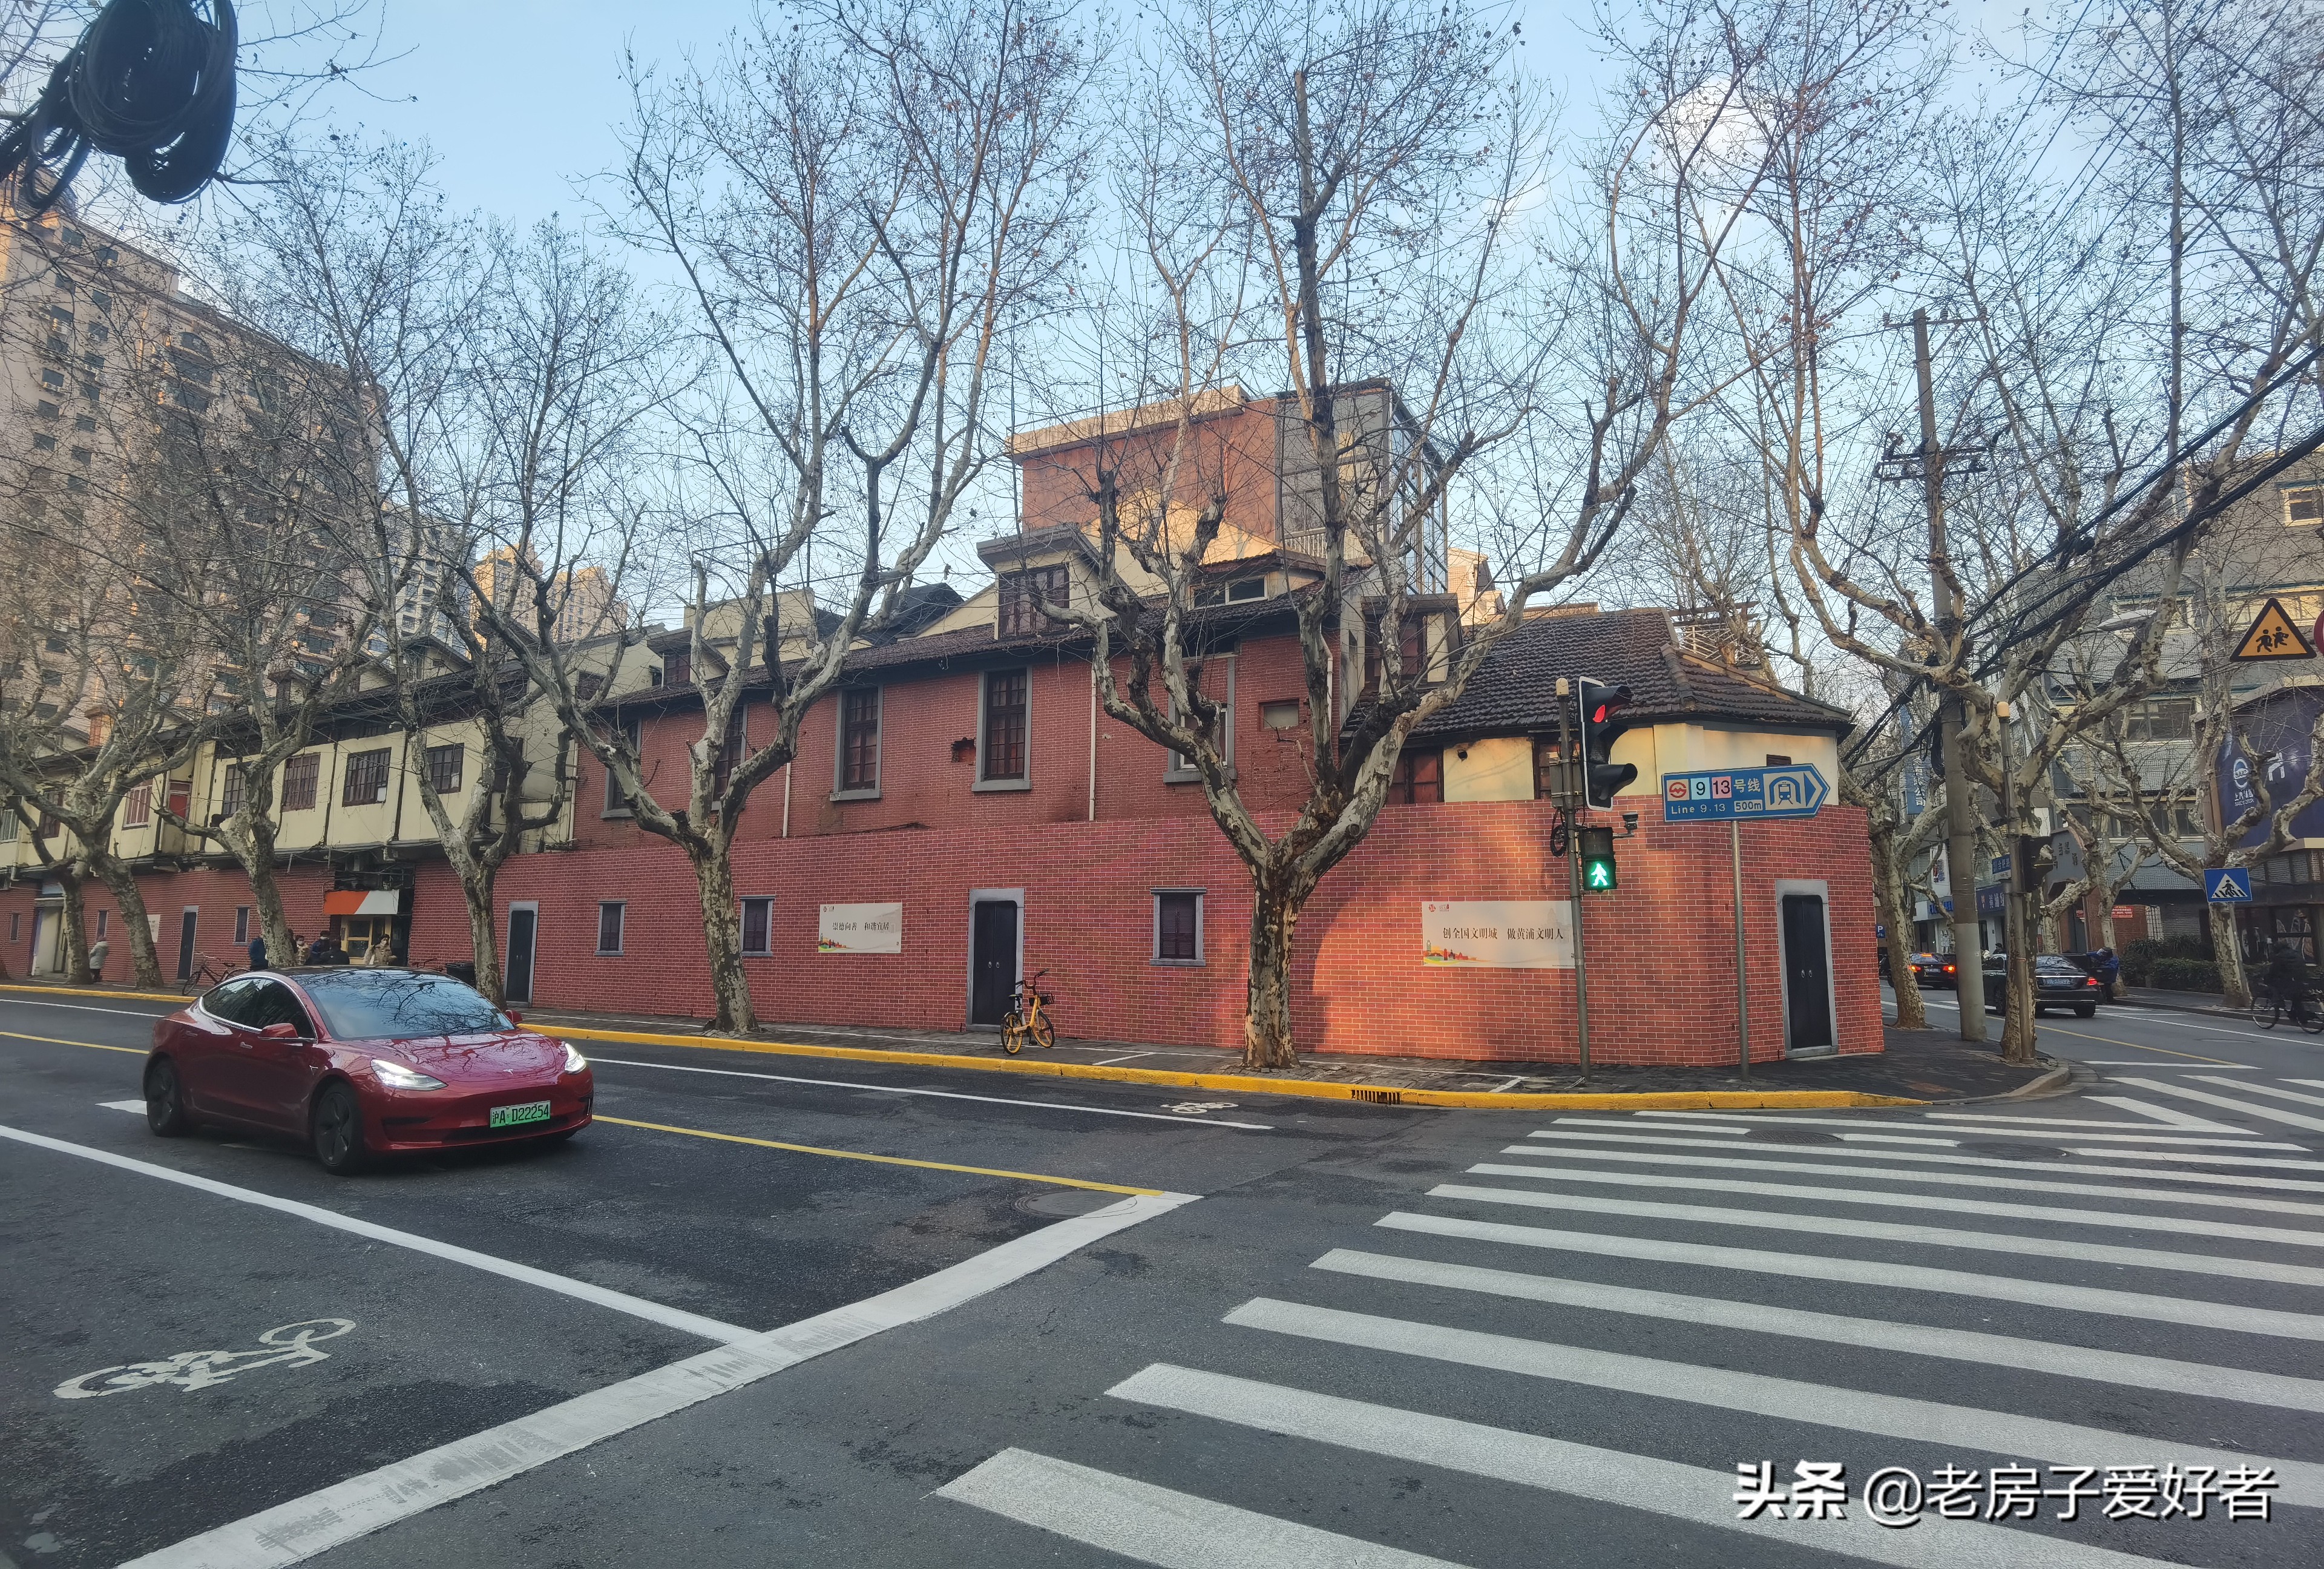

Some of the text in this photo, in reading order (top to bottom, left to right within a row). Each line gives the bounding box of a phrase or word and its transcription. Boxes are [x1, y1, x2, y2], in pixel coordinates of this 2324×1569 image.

[1696, 778, 1760, 795] 9 13 号线
[1672, 806, 1695, 814] Line
[1736, 802, 1761, 811] 500m
[833, 922, 889, 930] 崇德向善 和谐宜居
[1443, 927, 1564, 939] 创全国文明城 做黄浦文明人
